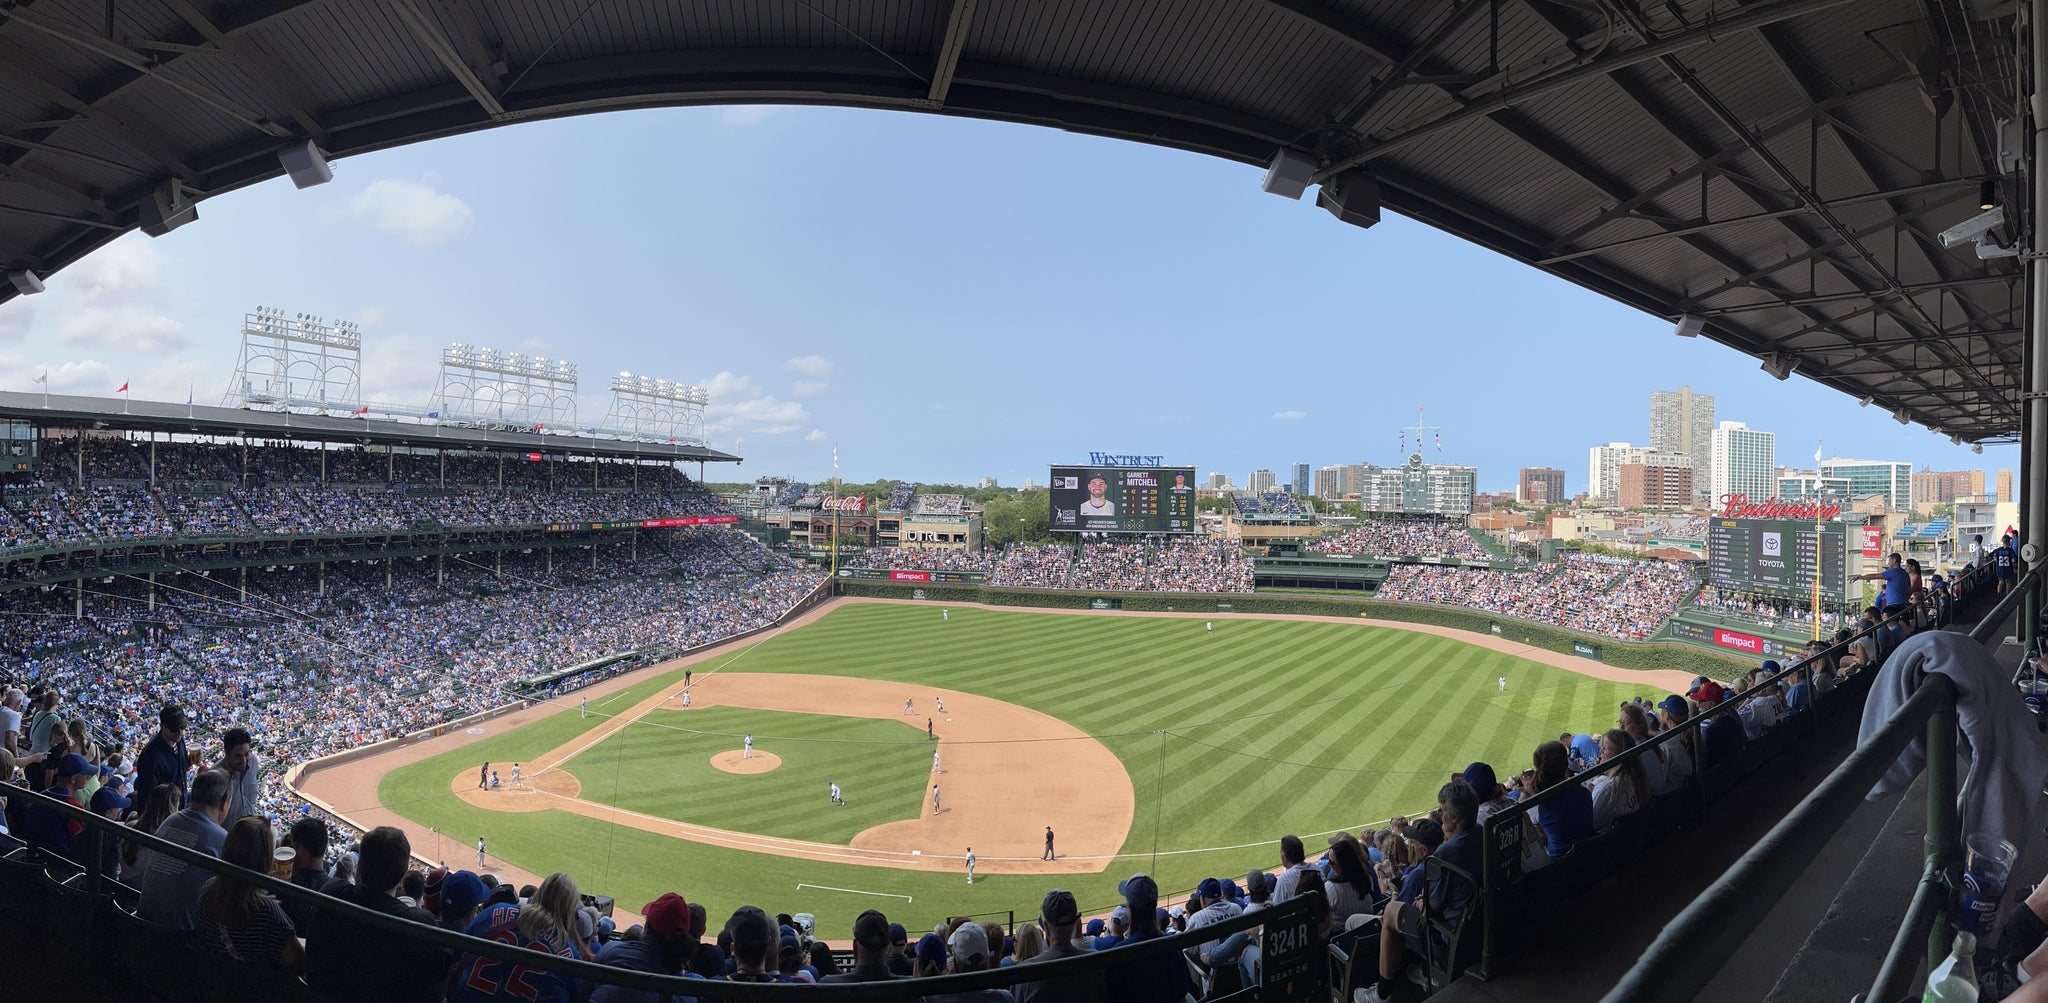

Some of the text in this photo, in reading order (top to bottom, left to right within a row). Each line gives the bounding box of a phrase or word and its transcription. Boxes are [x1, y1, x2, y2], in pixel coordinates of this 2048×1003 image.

[1126, 478, 1158, 486] MITCHELL
[1720, 493, 1841, 519] Budweiser
[1758, 559, 1785, 568] TOYOTA
[1998, 555, 2010, 567] 23
[901, 572, 925, 581] impact
[1727, 634, 1756, 649] impact
[1574, 645, 1593, 654] SLOAN
[1499, 824, 1519, 850] 326 R
[1269, 923, 1308, 957] 324 R
[1269, 963, 1309, 983] SEAT 26
